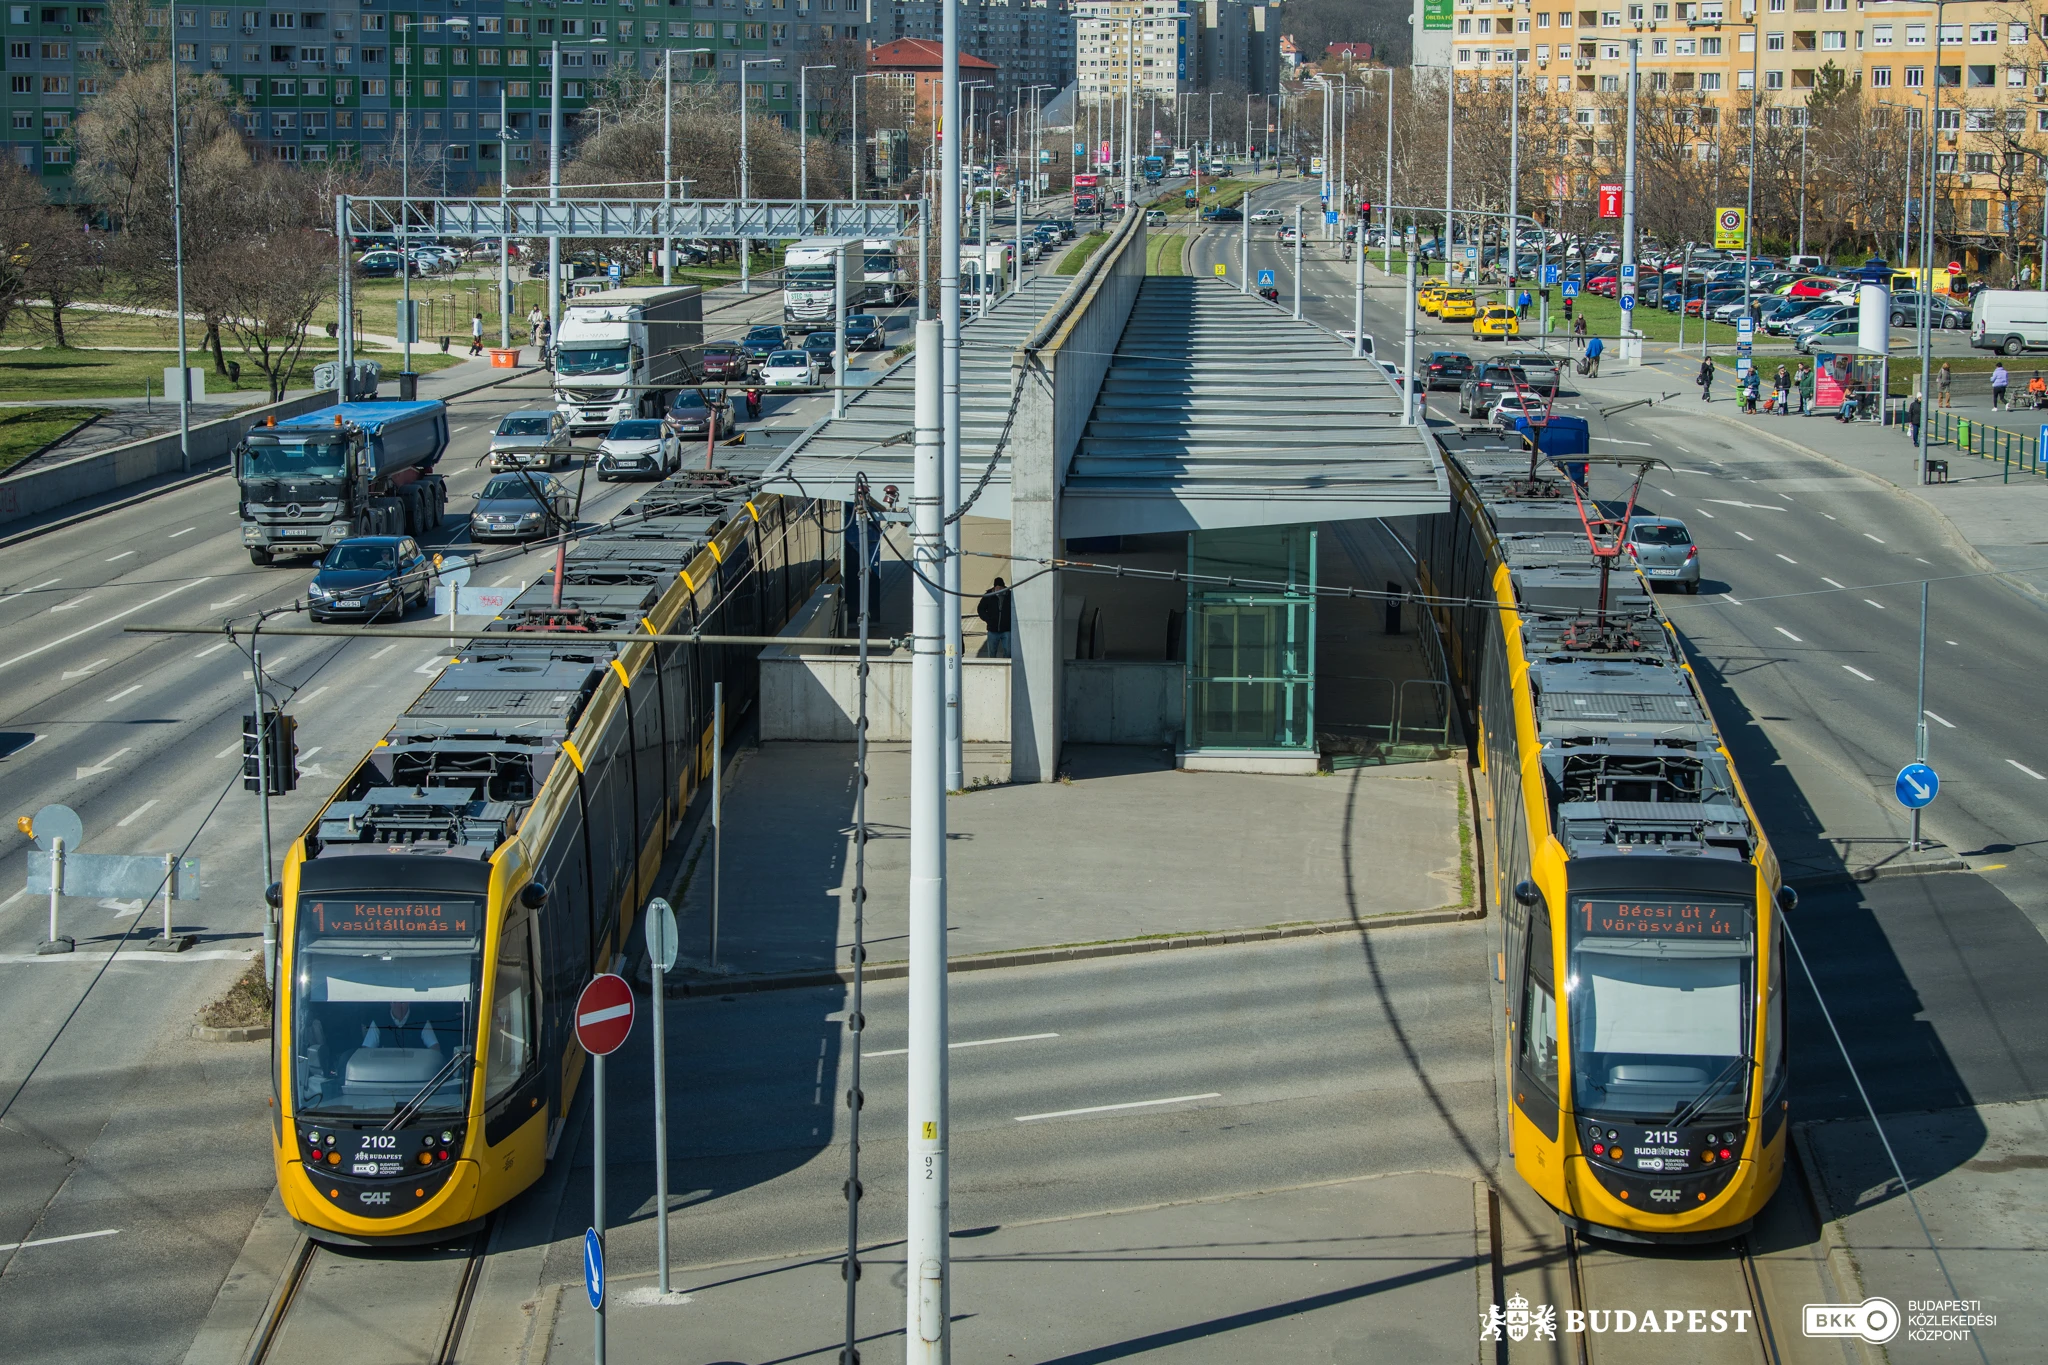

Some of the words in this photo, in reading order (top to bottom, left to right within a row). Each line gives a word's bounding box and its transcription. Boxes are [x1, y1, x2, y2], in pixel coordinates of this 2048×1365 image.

[313, 903, 324, 932] 1
[355, 904, 441, 916] Kelenföld
[1581, 902, 1593, 932] 1
[1619, 904, 1672, 918] Bécsi
[1681, 905, 1700, 918] út
[331, 918, 449, 931] vasútállomás
[455, 920, 466, 931] M
[1602, 919, 1702, 933] Vörösvári
[1711, 921, 1731, 934] út
[361, 1135, 396, 1148] 2102
[1644, 1130, 1678, 1144] 2115
[360, 1192, 391, 1205] CAF
[1650, 1189, 1681, 1202] CAF
